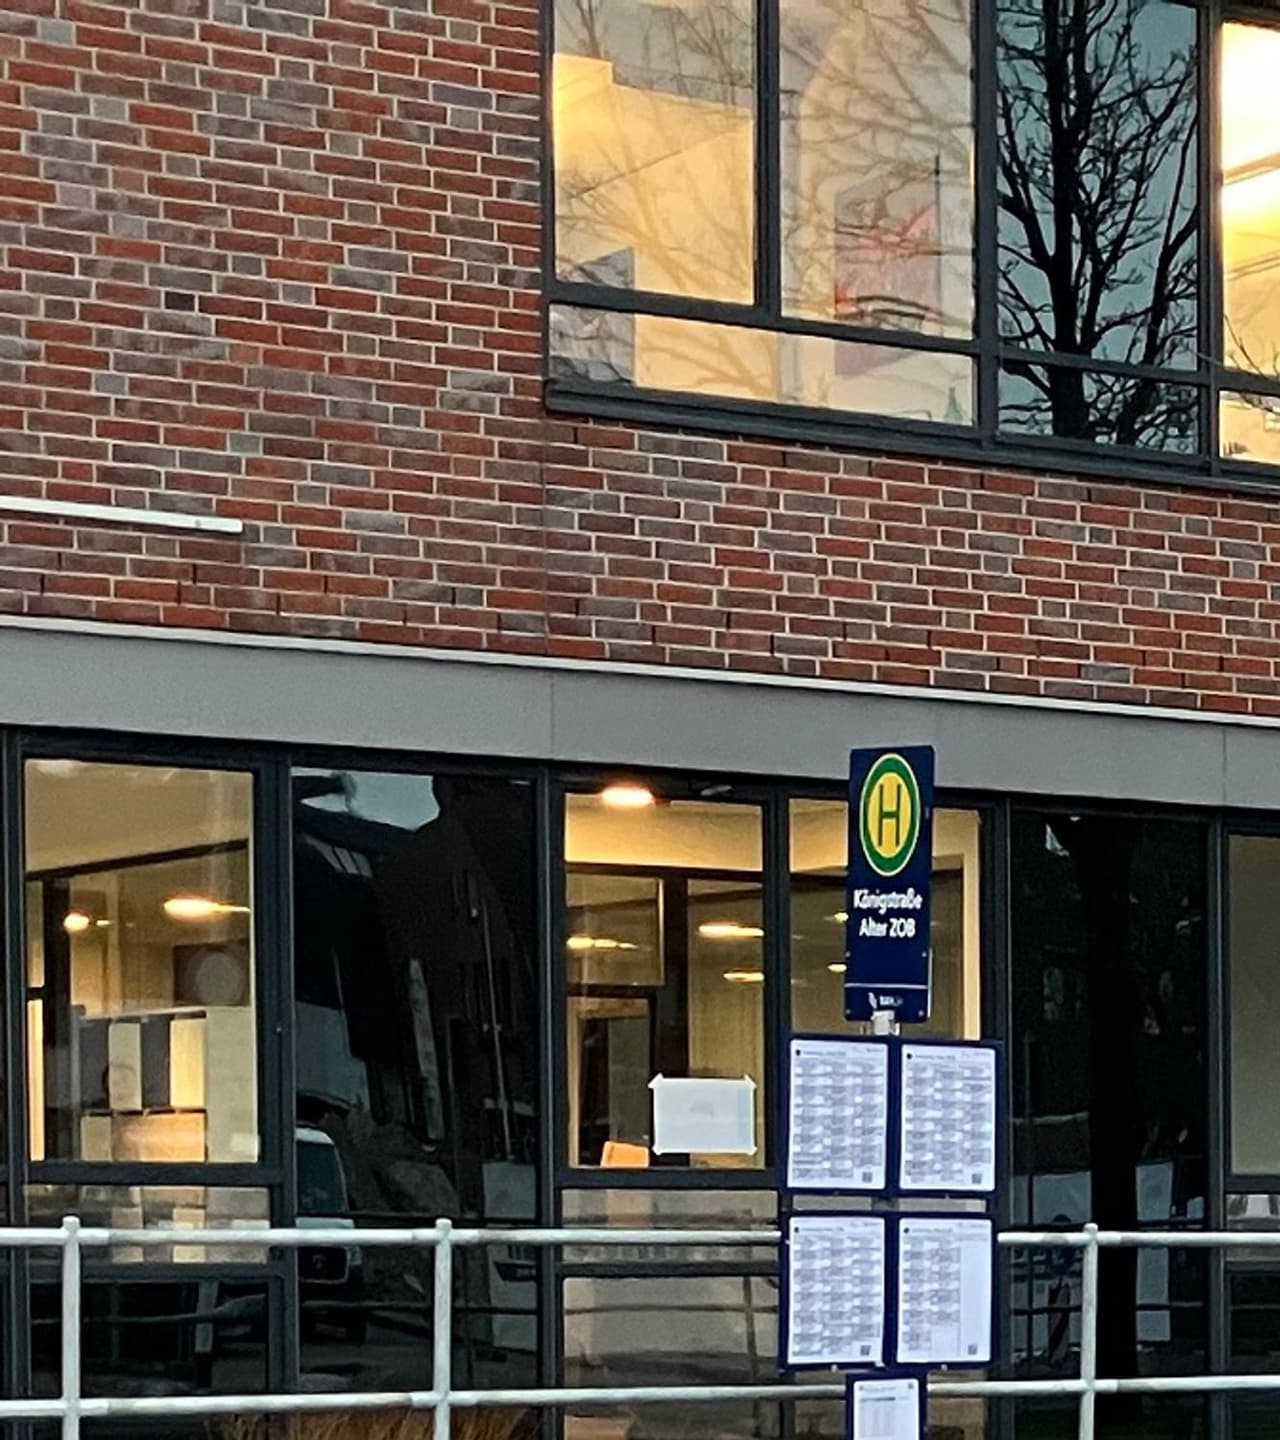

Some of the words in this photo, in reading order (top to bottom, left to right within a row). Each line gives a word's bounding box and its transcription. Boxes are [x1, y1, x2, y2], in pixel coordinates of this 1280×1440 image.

[878, 783, 901, 847] H
[859, 916, 888, 937] Alter
[889, 917, 916, 938] ZOB
